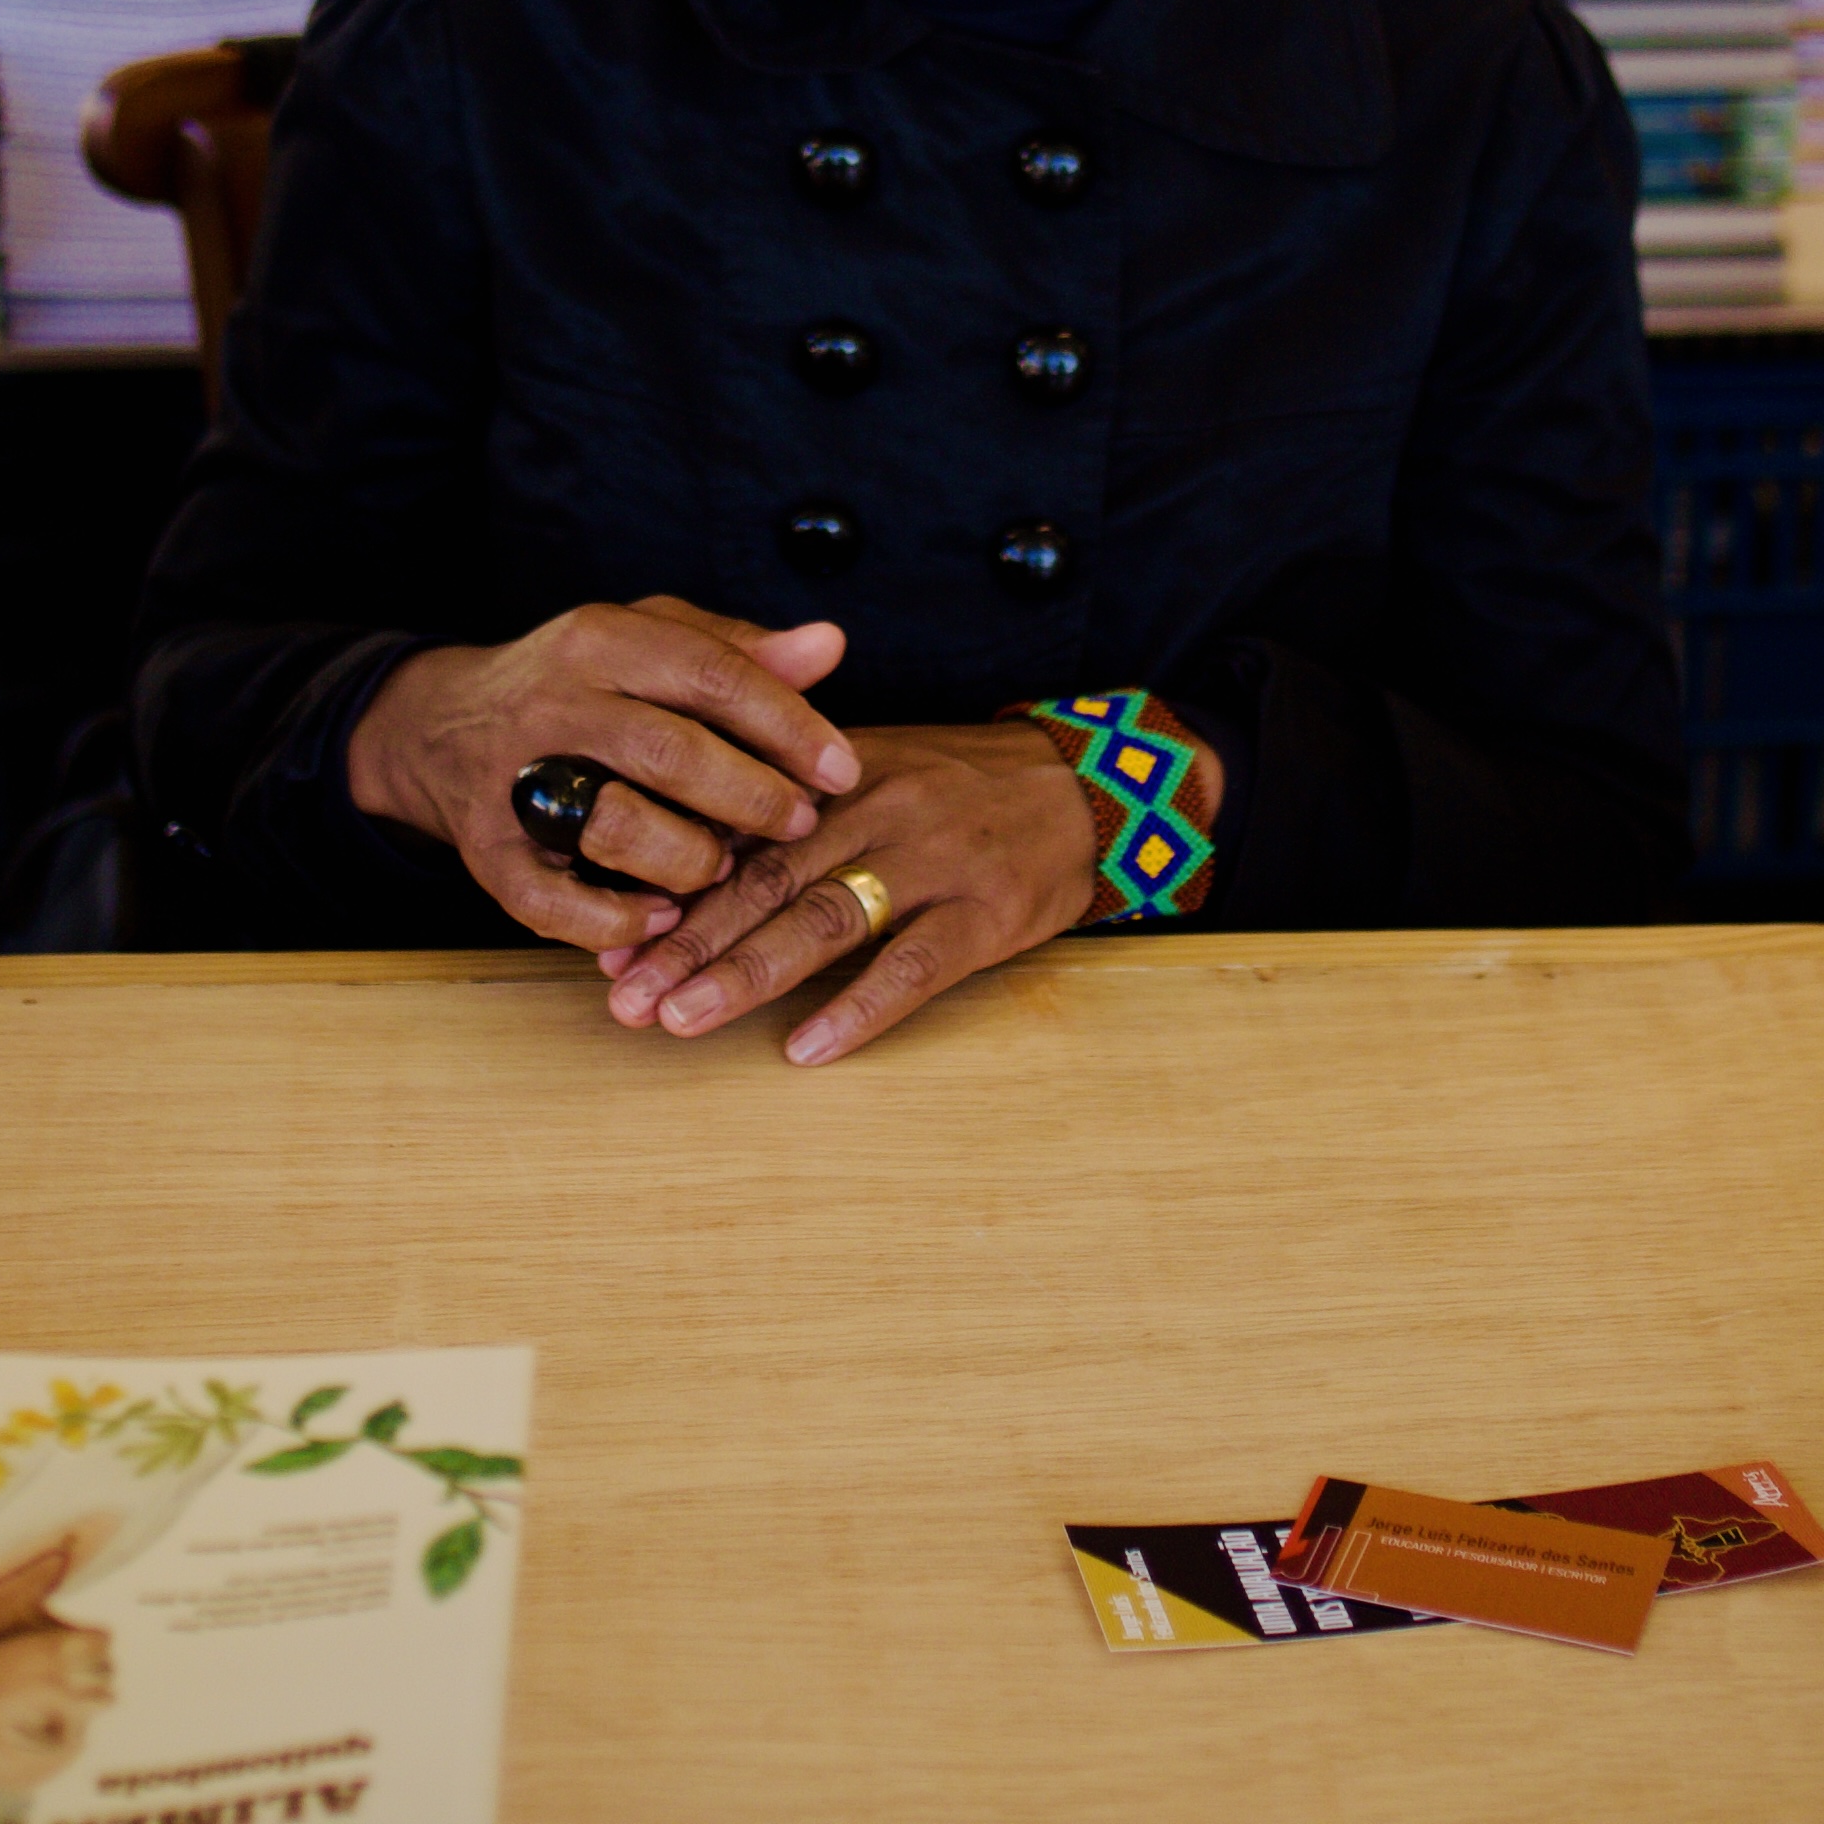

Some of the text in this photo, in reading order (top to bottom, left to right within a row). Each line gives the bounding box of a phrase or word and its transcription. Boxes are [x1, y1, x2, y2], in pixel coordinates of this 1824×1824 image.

[1368, 1517, 1414, 1537] Jorge
[1457, 1532, 1536, 1559] Felizardo
[1540, 1547, 1571, 1565] dos
[1576, 1554, 1635, 1578] Santos
[1380, 1536, 1445, 1557] EDUCADOR
[1454, 1549, 1539, 1573] PESQUISADOR
[1548, 1564, 1608, 1586] ESCRITOR
[1217, 1528, 1298, 1635] UMA AVALIAÇÃO
[1309, 1598, 1354, 1631] DOS
